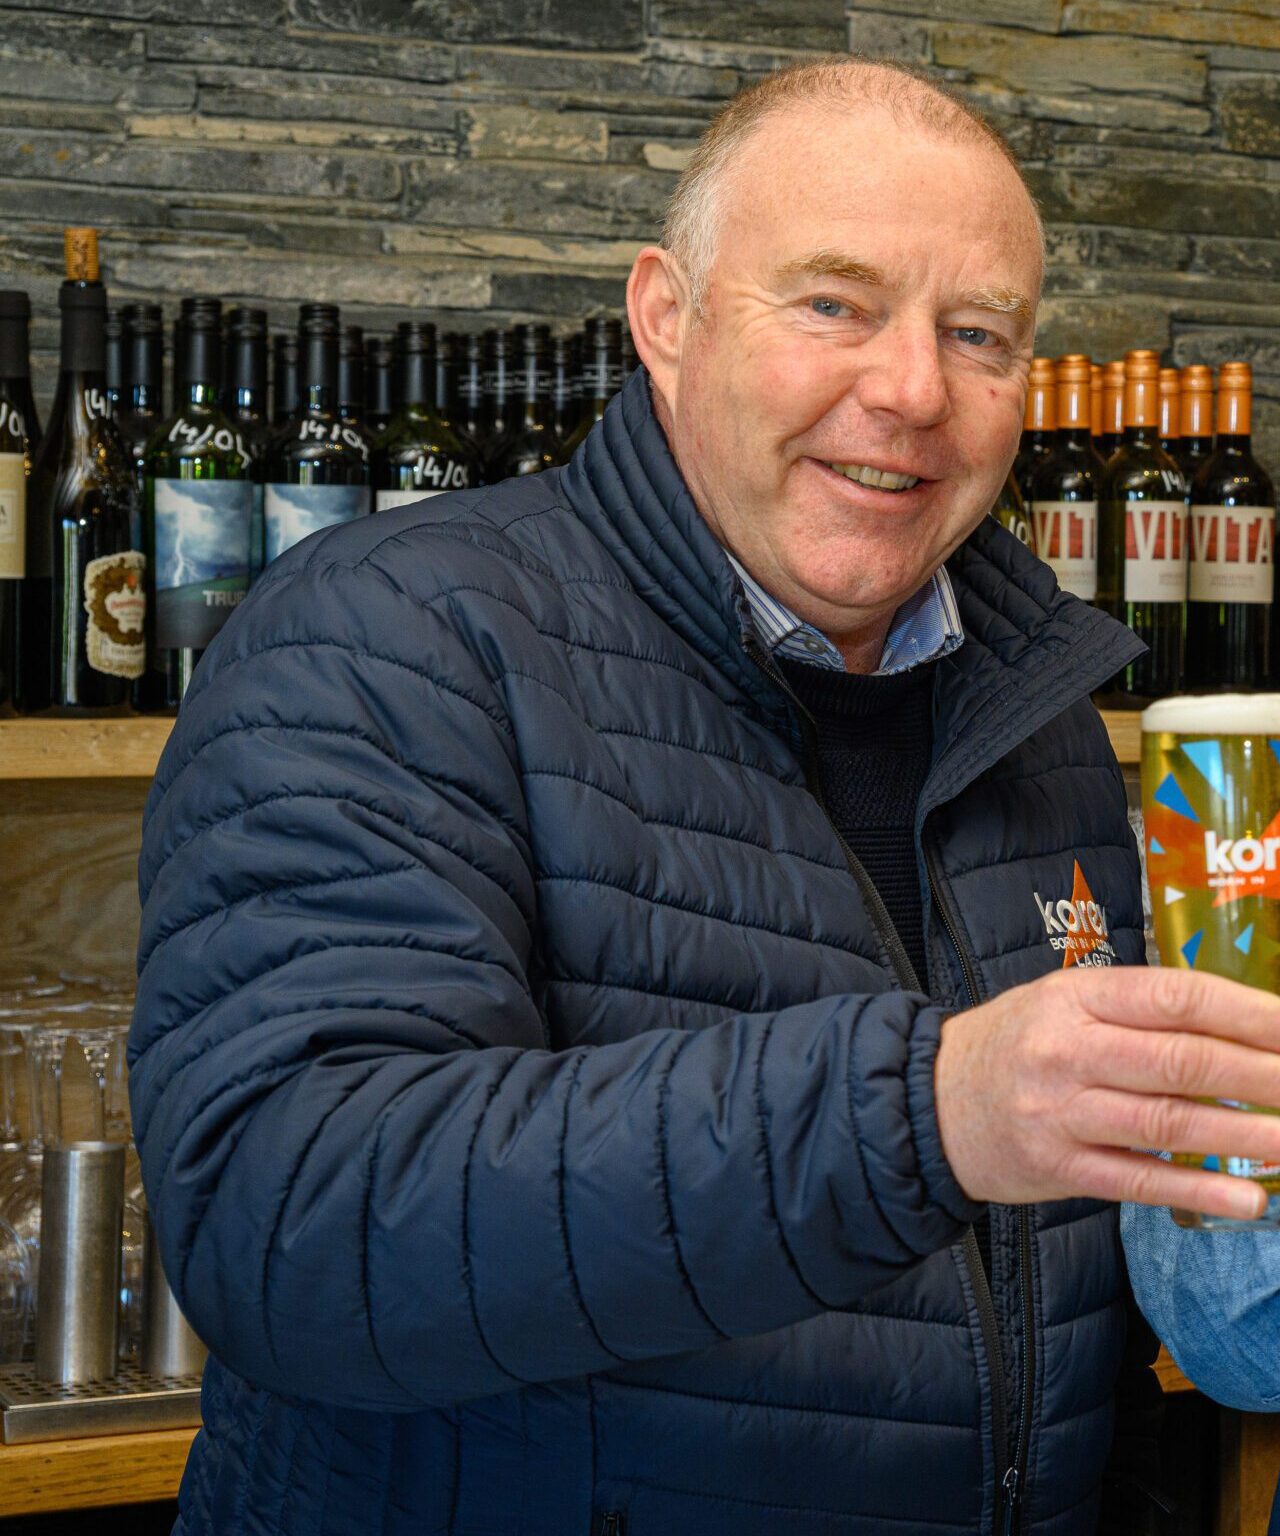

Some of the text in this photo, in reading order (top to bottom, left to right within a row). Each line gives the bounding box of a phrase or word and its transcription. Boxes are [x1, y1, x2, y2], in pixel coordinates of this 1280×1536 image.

[1191, 515, 1272, 563] VITA
[1208, 876, 1246, 887] BORN
[1251, 875, 1265, 885] IN
[1049, 937, 1076, 950] BORN
[1078, 937, 1090, 949] IN
